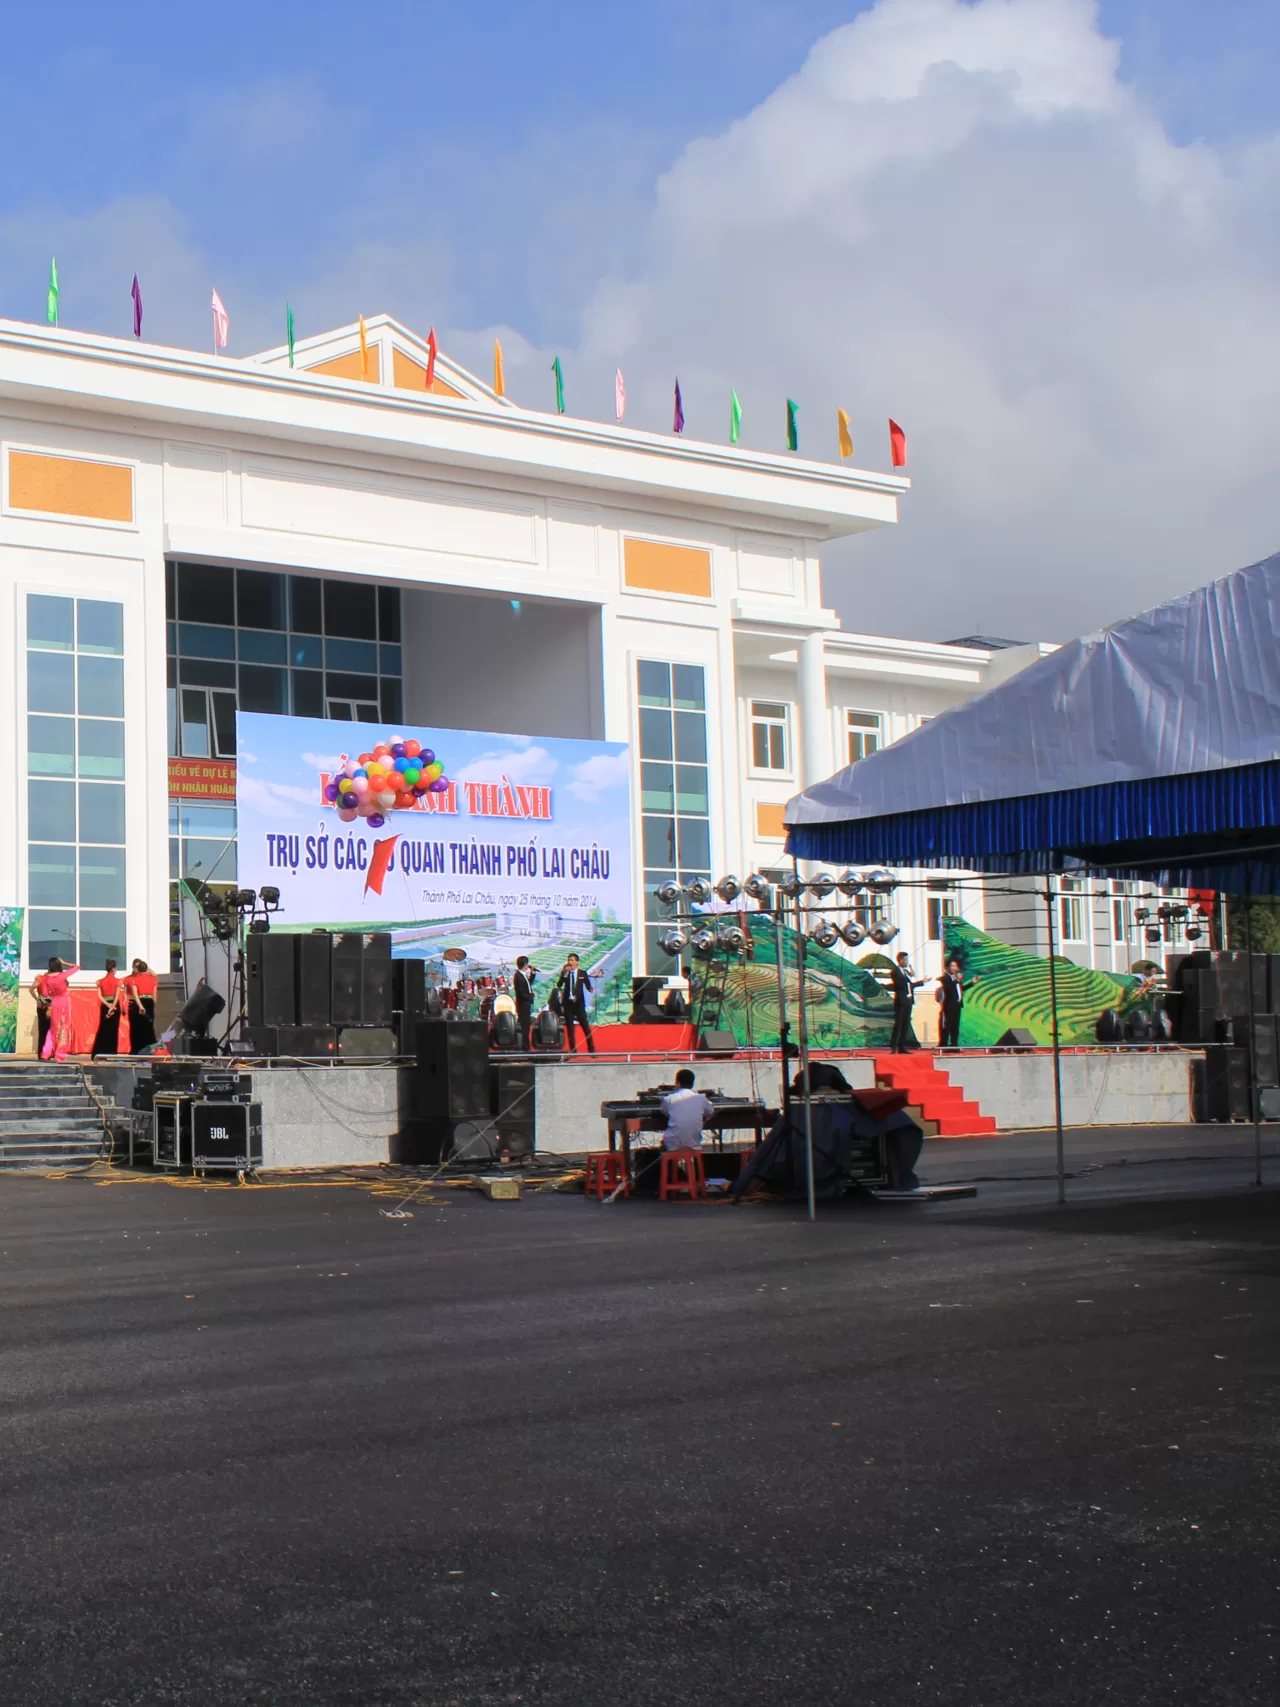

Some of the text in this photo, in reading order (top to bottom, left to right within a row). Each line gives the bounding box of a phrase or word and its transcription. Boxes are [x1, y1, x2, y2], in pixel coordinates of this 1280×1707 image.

[464, 775, 552, 818] THÀNH
[267, 834, 299, 875] TRỤ
[306, 822, 329, 869] SỞ
[334, 831, 367, 871] CÁC
[401, 840, 445, 876] QUAN
[450, 837, 501, 875] THÀNH
[507, 835, 537, 877] PHỐ
[542, 847, 565, 878] LAI
[570, 843, 610, 880] CHÂU
[422, 889, 445, 903] Thành
[446, 889, 462, 904] Phố
[462, 891, 474, 904] Lai
[475, 892, 496, 905] Châu,
[498, 892, 518, 908] ngày
[530, 893, 551, 909] tháng
[553, 894, 562, 906] 10
[563, 894, 579, 907] năm
[580, 894, 597, 907] 2014
[210, 1127, 229, 1139] JBL
